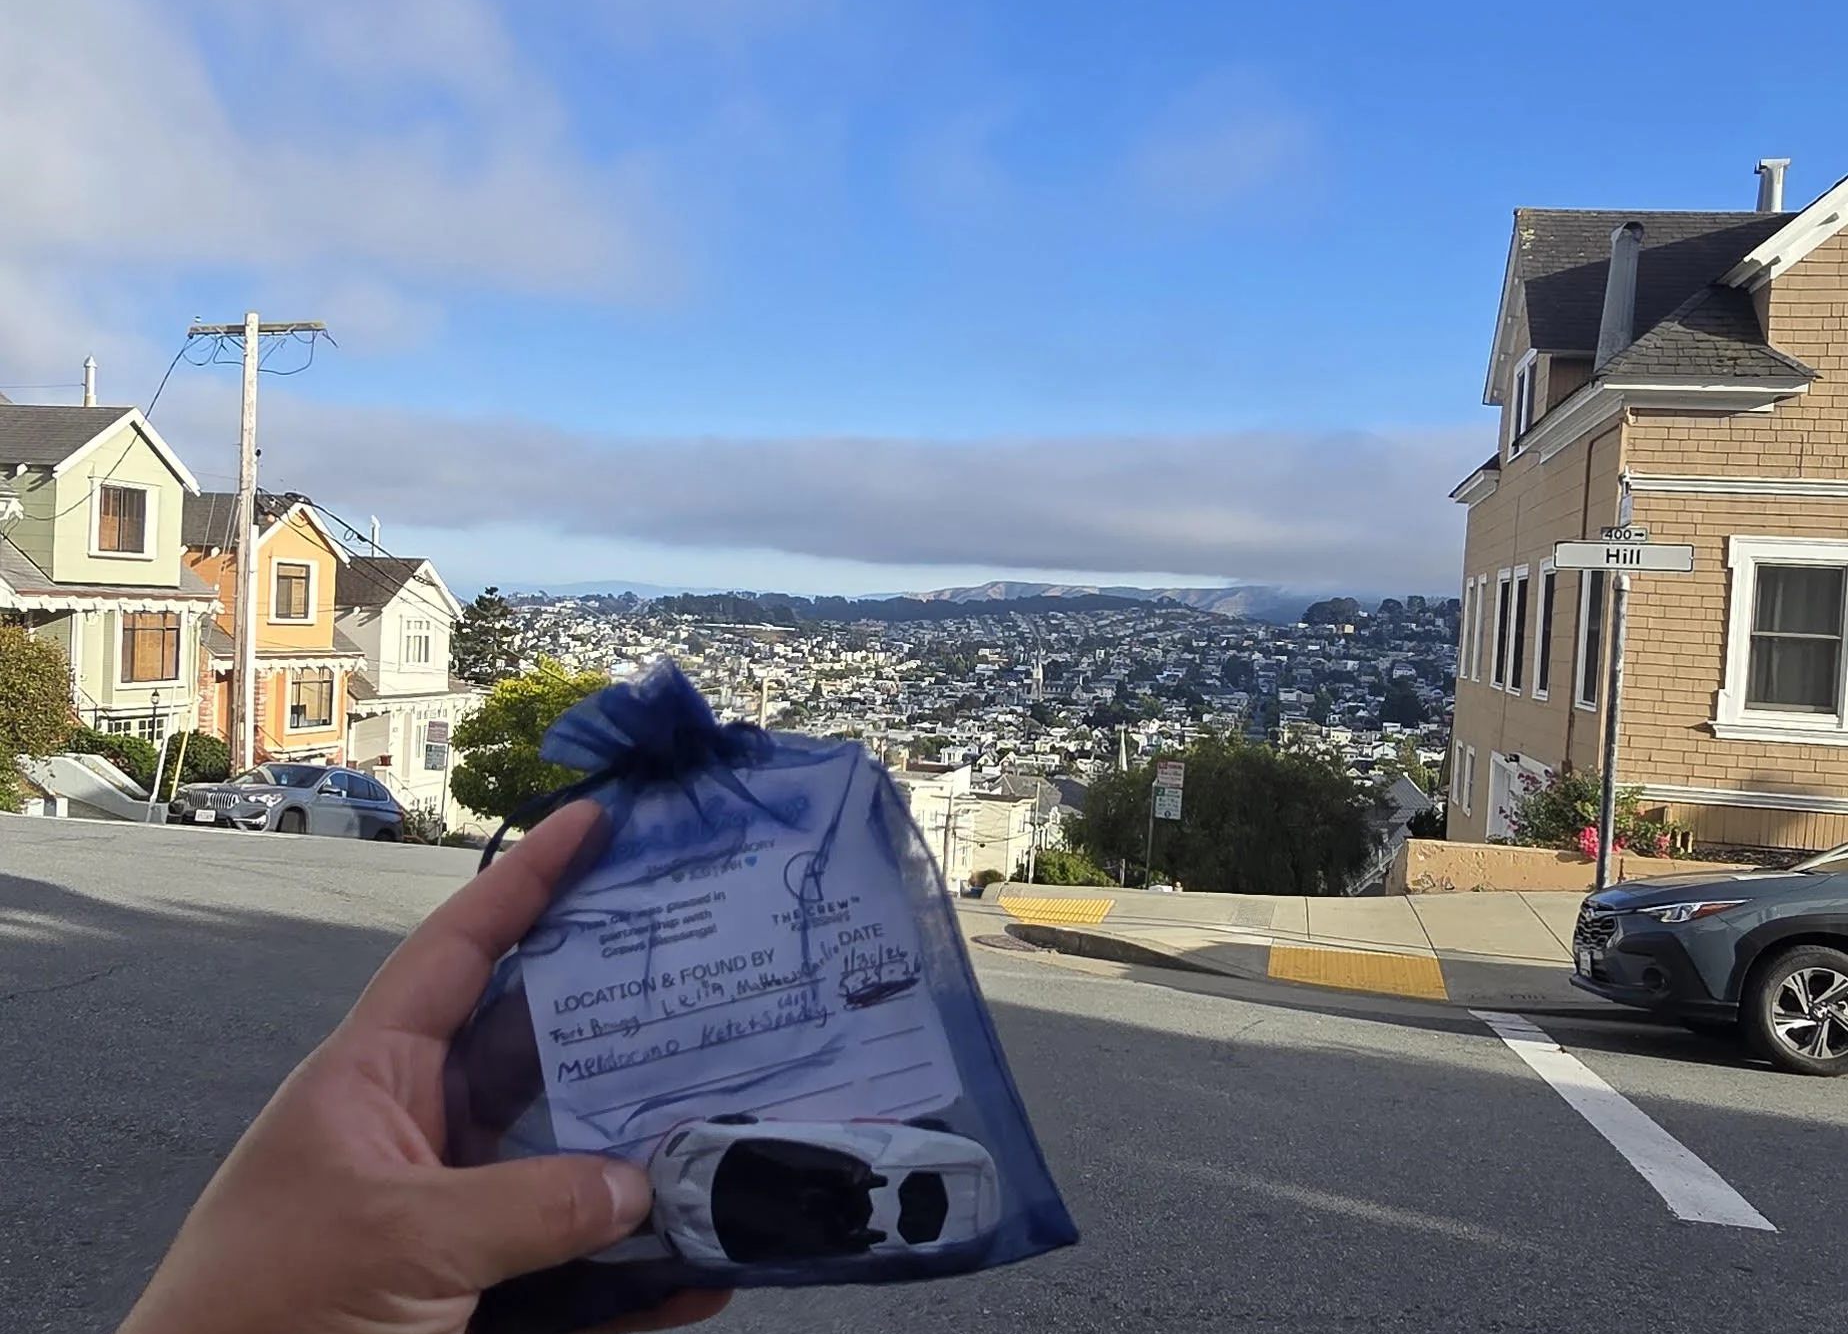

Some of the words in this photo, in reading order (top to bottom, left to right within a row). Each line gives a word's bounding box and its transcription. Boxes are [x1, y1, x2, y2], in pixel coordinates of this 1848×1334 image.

[1604, 529, 1632, 540] 400
[1606, 548, 1641, 565] Hill
[713, 890, 727, 902] in
[772, 908, 800, 926] THE
[838, 922, 885, 947] DATE
[553, 976, 657, 1015] LOCATION
[661, 972, 676, 988] &
[680, 954, 747, 986] FOUND
[751, 947, 775, 967] BY
